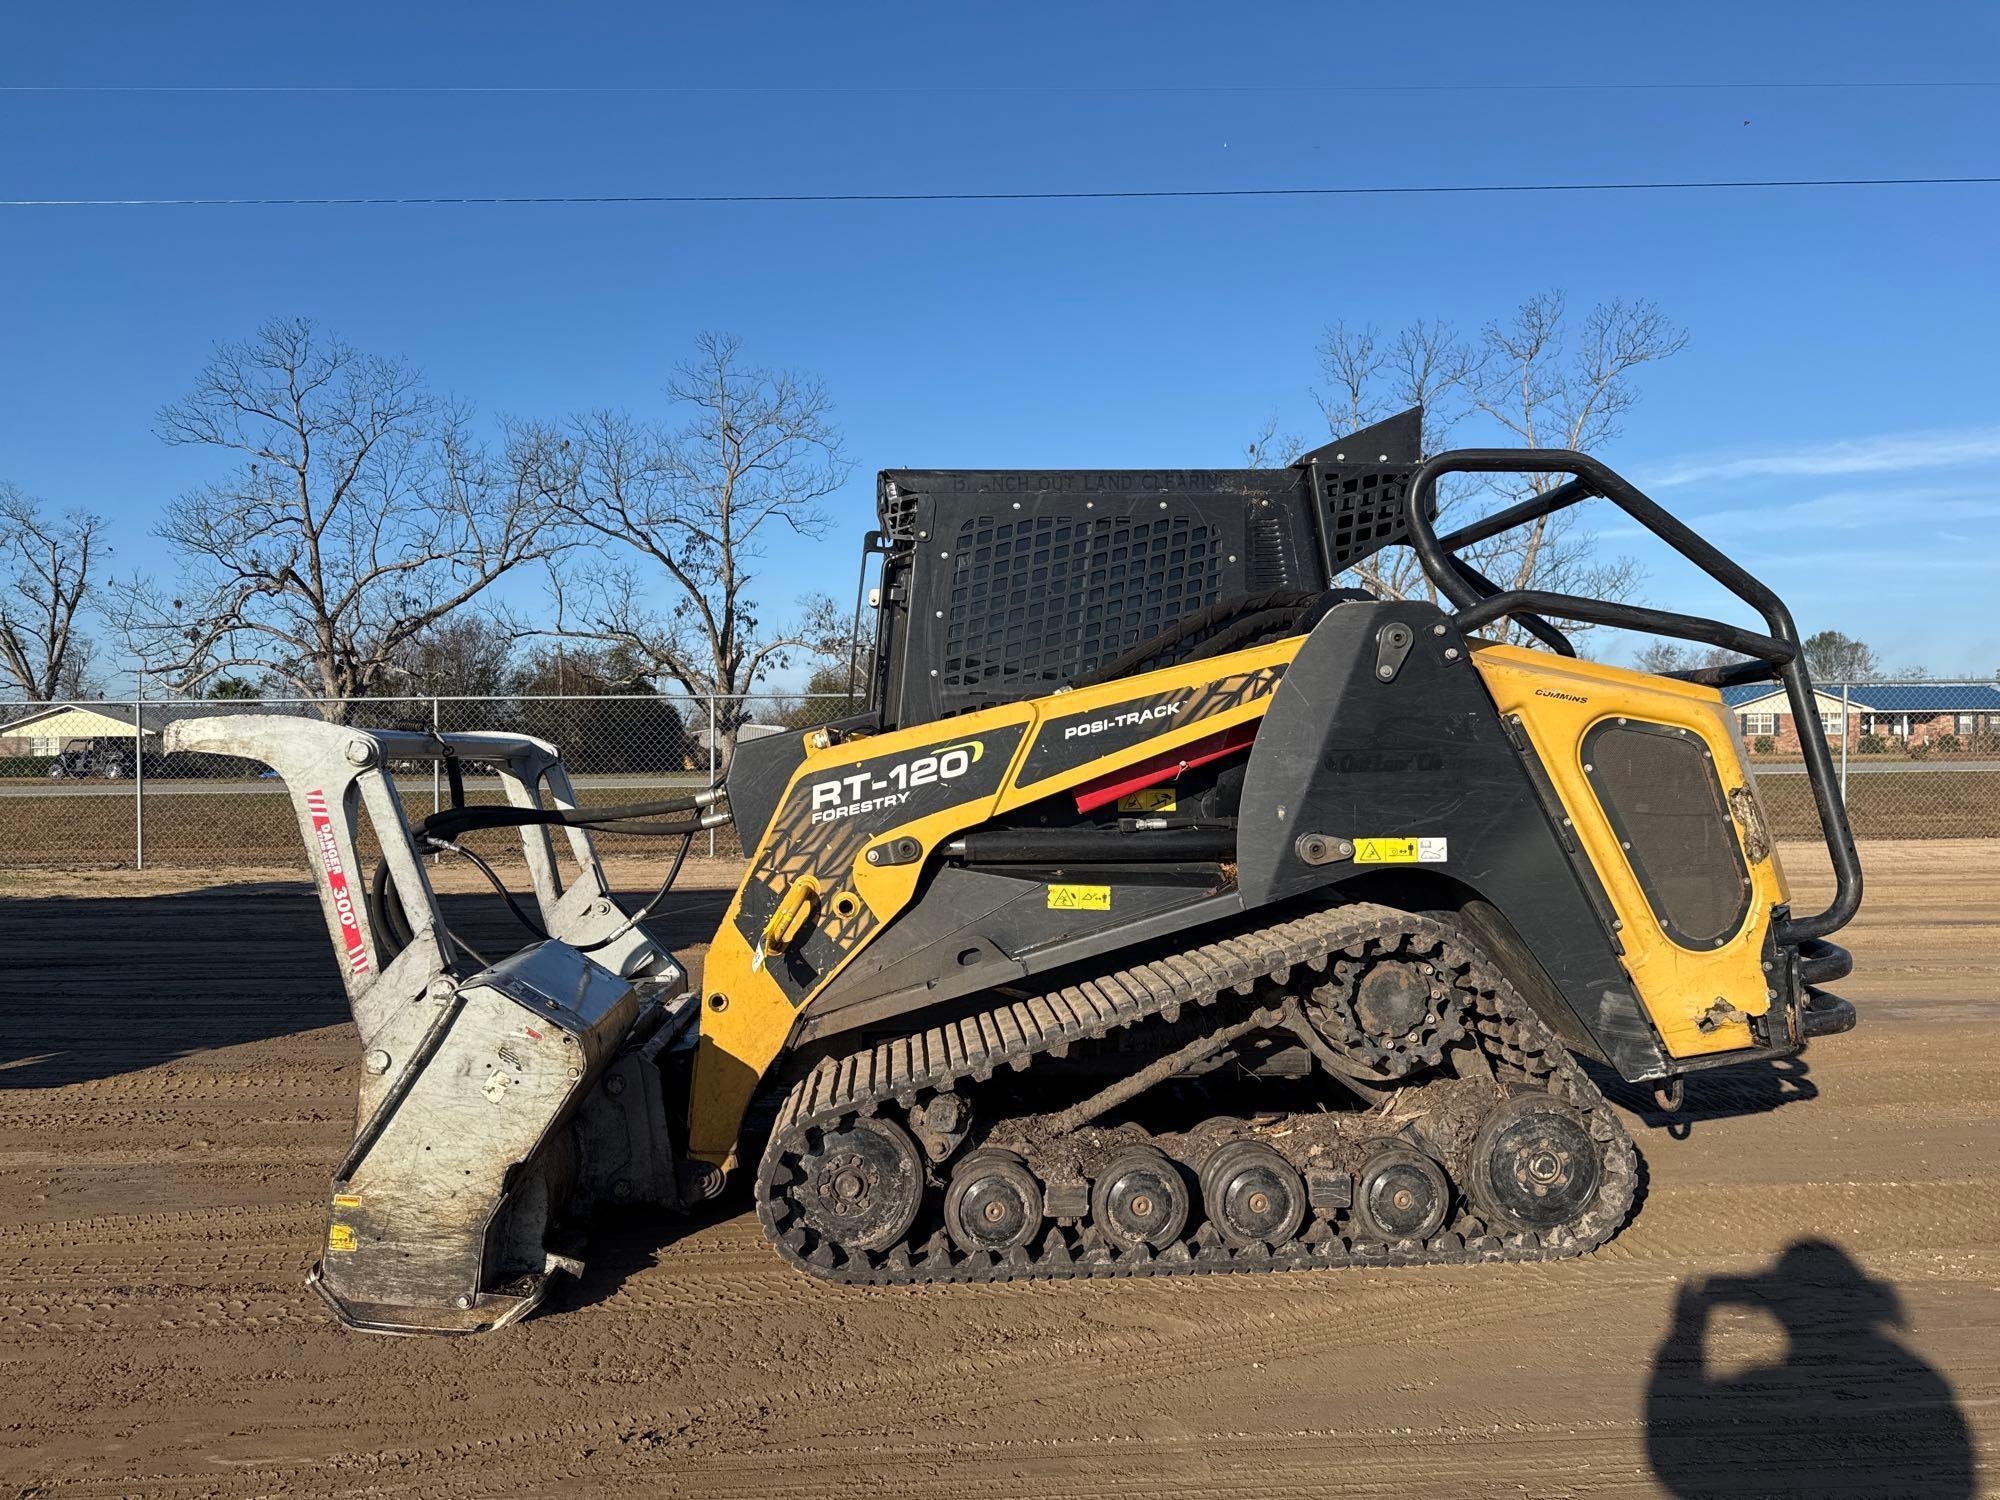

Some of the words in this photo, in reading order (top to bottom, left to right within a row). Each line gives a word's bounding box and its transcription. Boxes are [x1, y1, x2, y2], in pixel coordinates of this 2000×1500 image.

[1084, 475, 1132, 491] LAND
[1141, 474, 1231, 490] CLEARIN
[1535, 689, 1589, 704] CUMMINS
[1064, 701, 1181, 740] POSI-TRACK
[811, 750, 969, 811] RT-120
[811, 791, 911, 825] FORESTRY
[321, 823, 343, 875] DANGER
[333, 886, 358, 930] 300'
